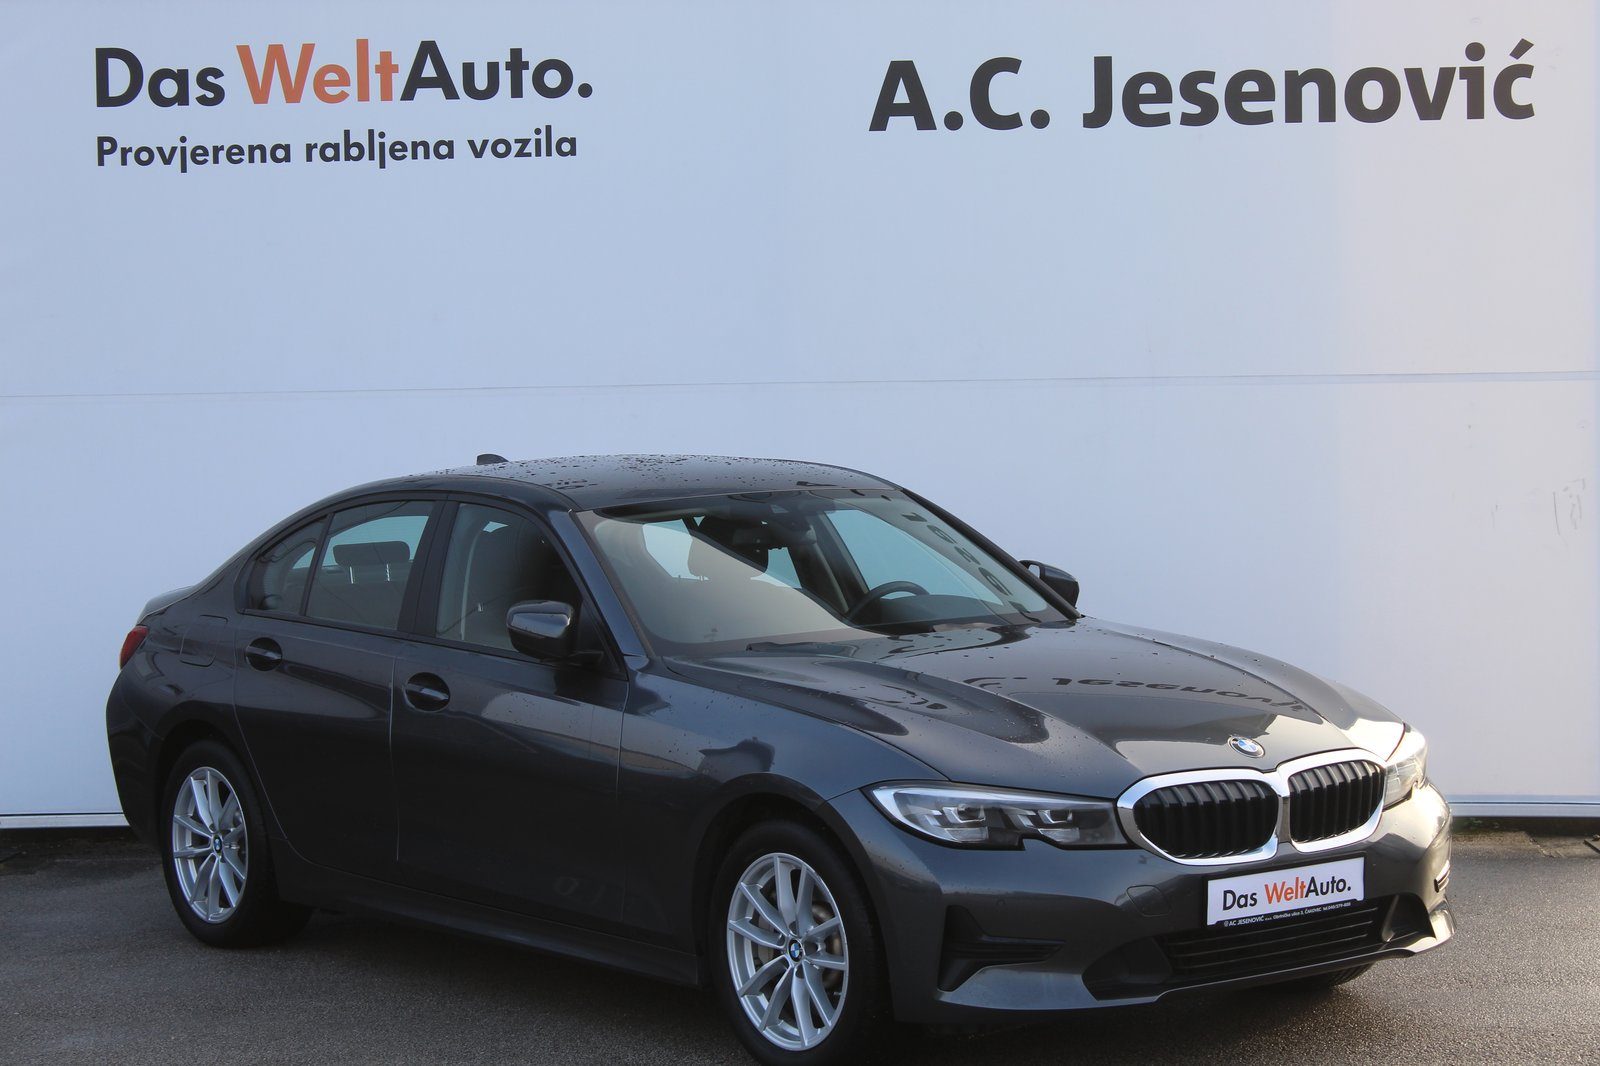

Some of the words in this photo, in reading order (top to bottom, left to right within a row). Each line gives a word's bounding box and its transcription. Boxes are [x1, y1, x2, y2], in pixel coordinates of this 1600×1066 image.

[95, 46, 225, 108] Das
[236, 38, 593, 105] WeltAuto.
[868, 56, 1050, 131] A.C.
[1082, 38, 1535, 128] Jesenović
[97, 135, 291, 173] Provjerena
[304, 129, 454, 169] rabljena
[467, 125, 577, 159] vozila
[1222, 889, 1258, 911] Das
[1264, 876, 1352, 905] WeltAuto.
[1237, 915, 1265, 926] JESENOVIĆ
